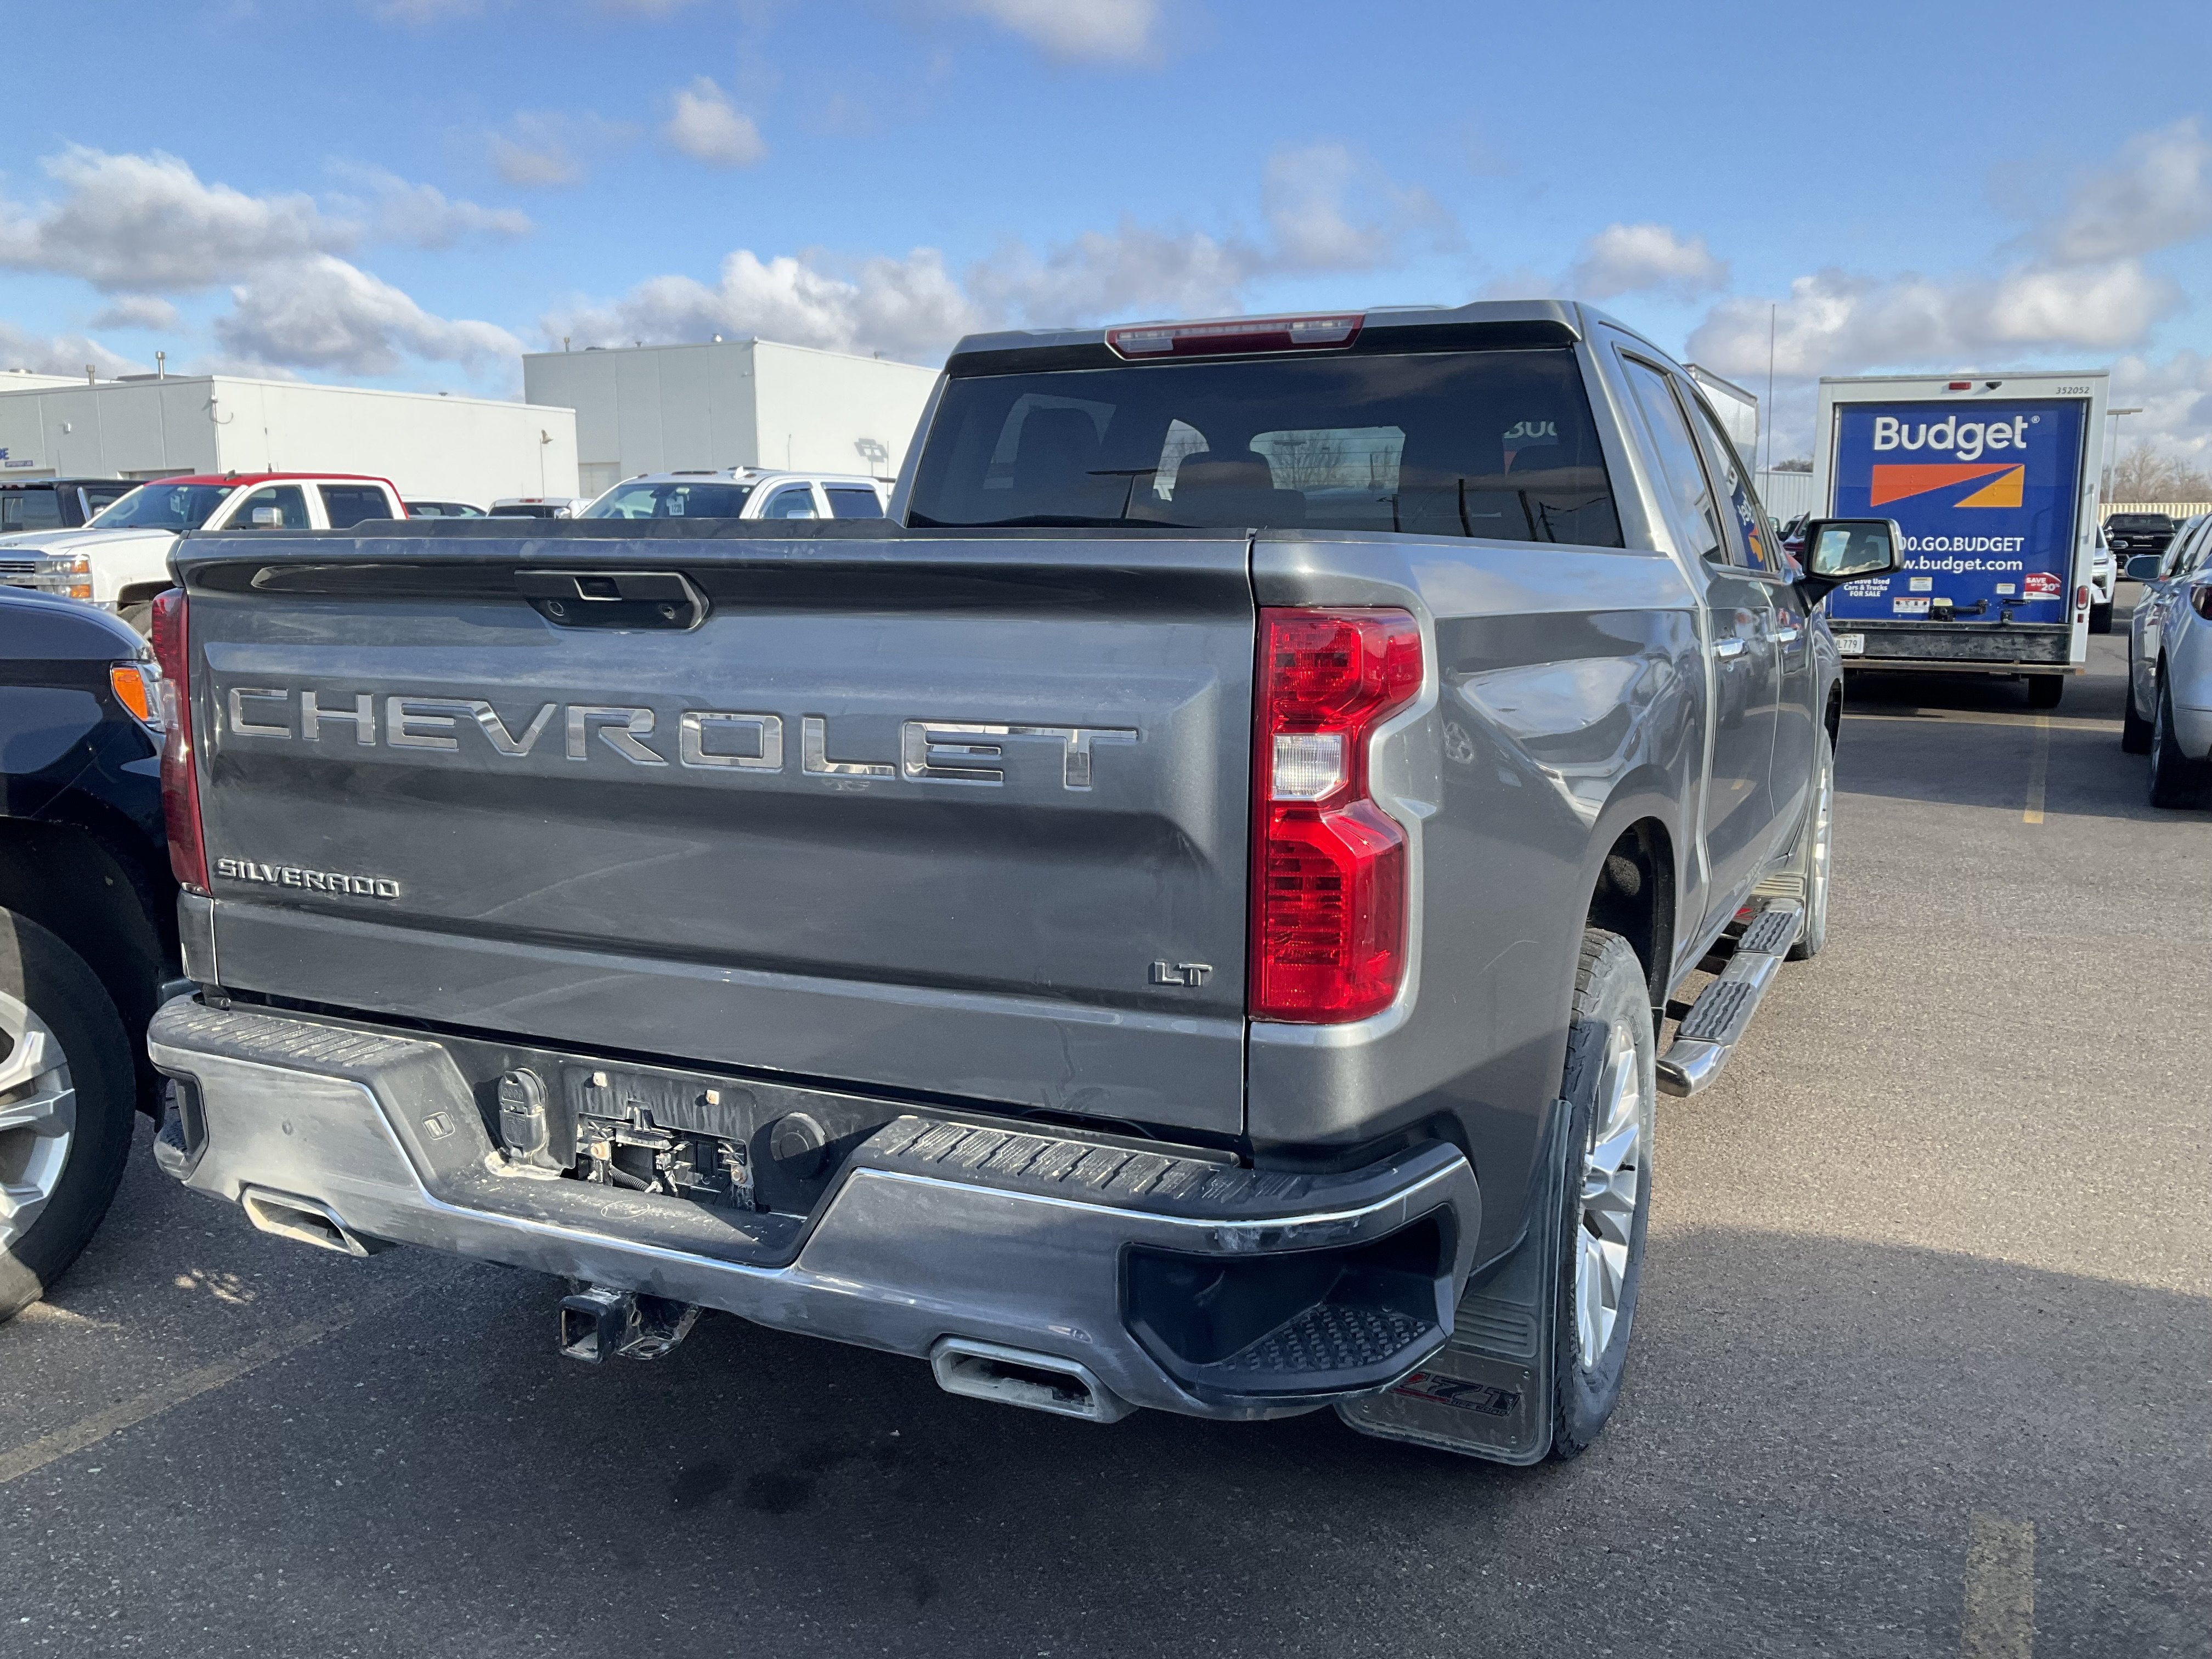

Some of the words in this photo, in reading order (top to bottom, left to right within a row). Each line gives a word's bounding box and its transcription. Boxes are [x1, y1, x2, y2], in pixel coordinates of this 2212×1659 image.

[229, 686, 1139, 791] CHEVROLET
[217, 857, 401, 899] SILVERADO
[1153, 961, 1214, 986] LT
